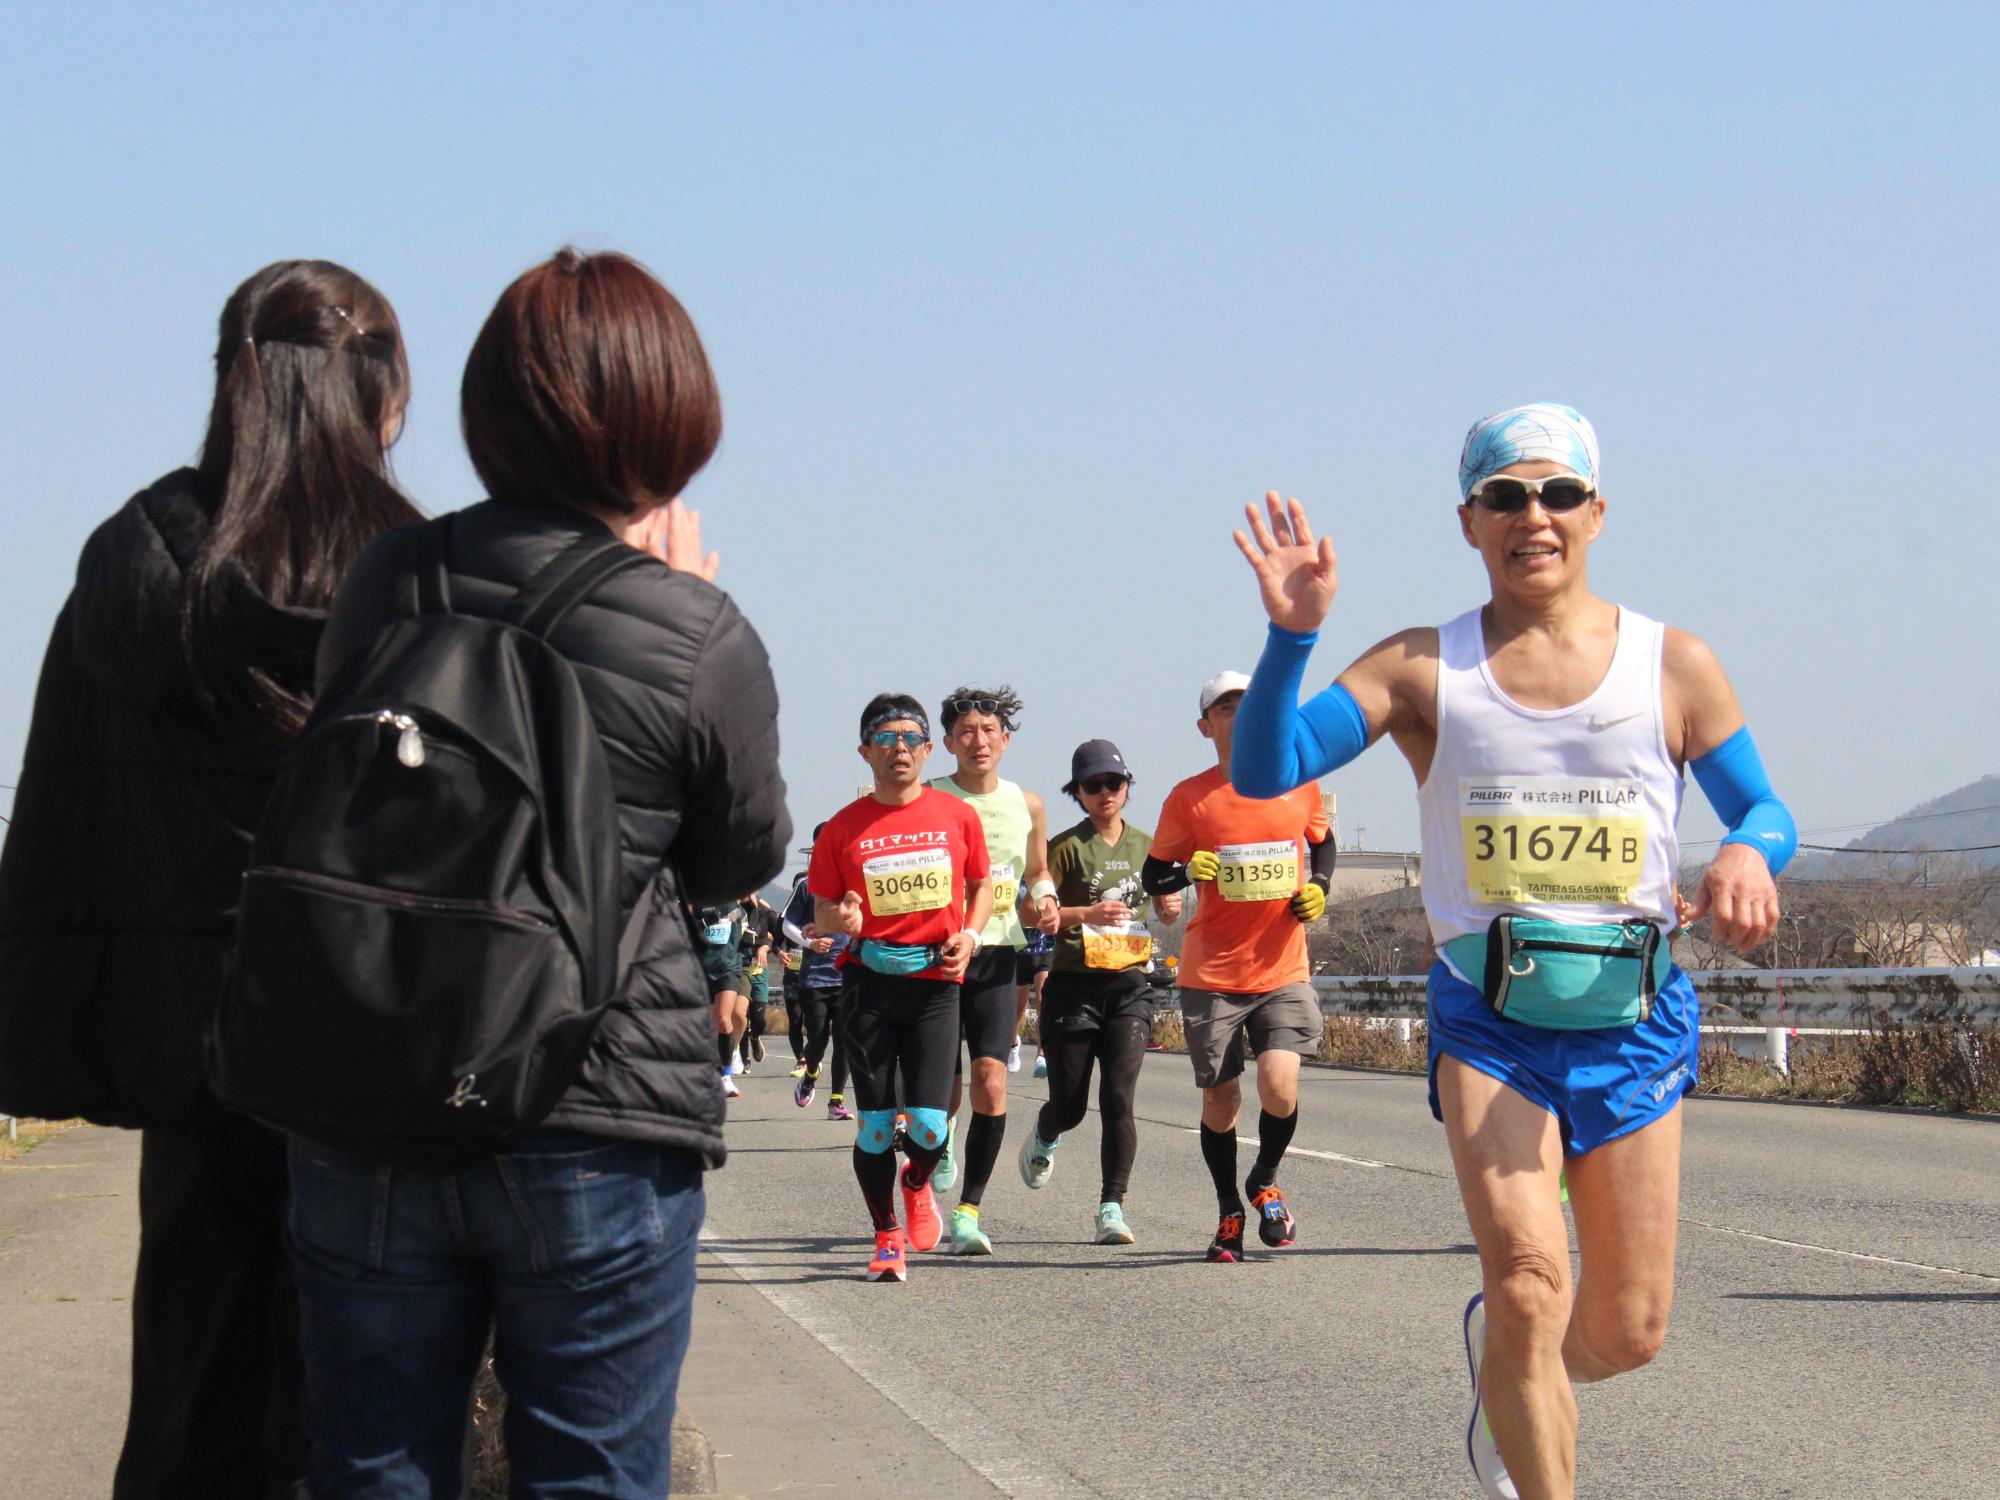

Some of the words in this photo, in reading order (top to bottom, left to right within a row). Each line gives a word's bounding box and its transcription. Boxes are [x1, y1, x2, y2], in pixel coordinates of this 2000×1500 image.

[1469, 791, 1512, 800] PILLAR
[1522, 791, 1573, 803] 株式会社
[1578, 789, 1637, 804] PILLAR
[860, 831, 948, 849] タイマックス
[1474, 824, 1612, 862] 31674
[1622, 837, 1637, 863] B
[1223, 863, 1284, 883] 31359
[1288, 866, 1295, 878] B
[872, 872, 938, 897] 30646
[942, 875, 949, 888] A
